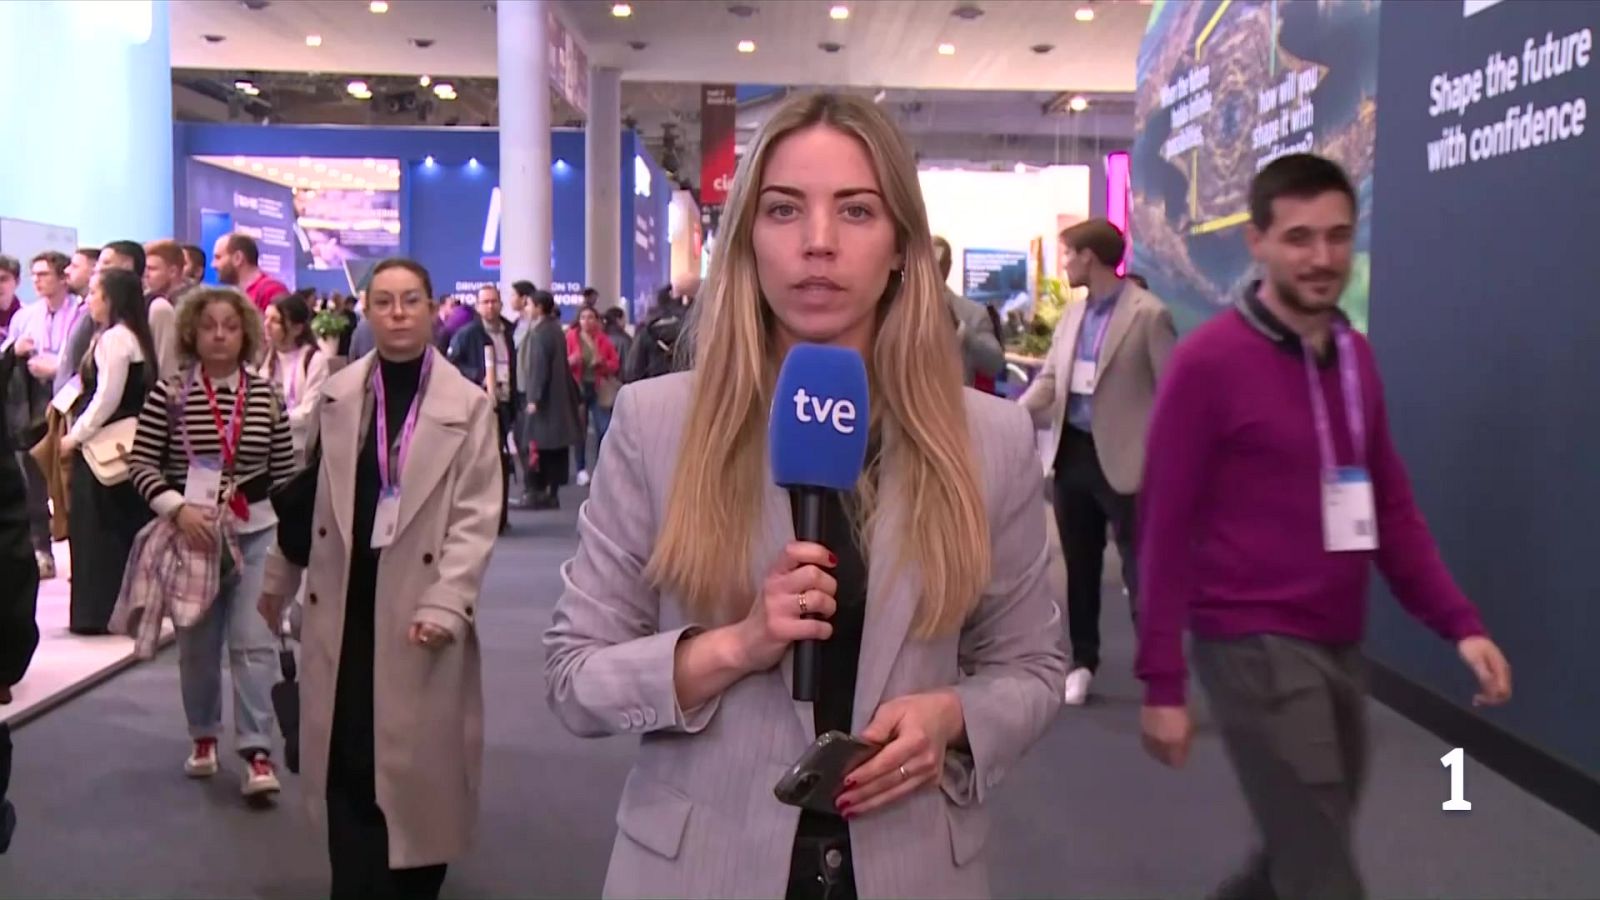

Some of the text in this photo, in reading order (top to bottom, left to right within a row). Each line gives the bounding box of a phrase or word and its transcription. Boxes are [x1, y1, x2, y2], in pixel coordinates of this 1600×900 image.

[1257, 64, 1318, 114] how will you
[1429, 28, 1592, 117] Shape the future
[1252, 98, 1314, 150] shape it with
[1427, 97, 1587, 172] with confidence
[793, 388, 856, 434] tve
